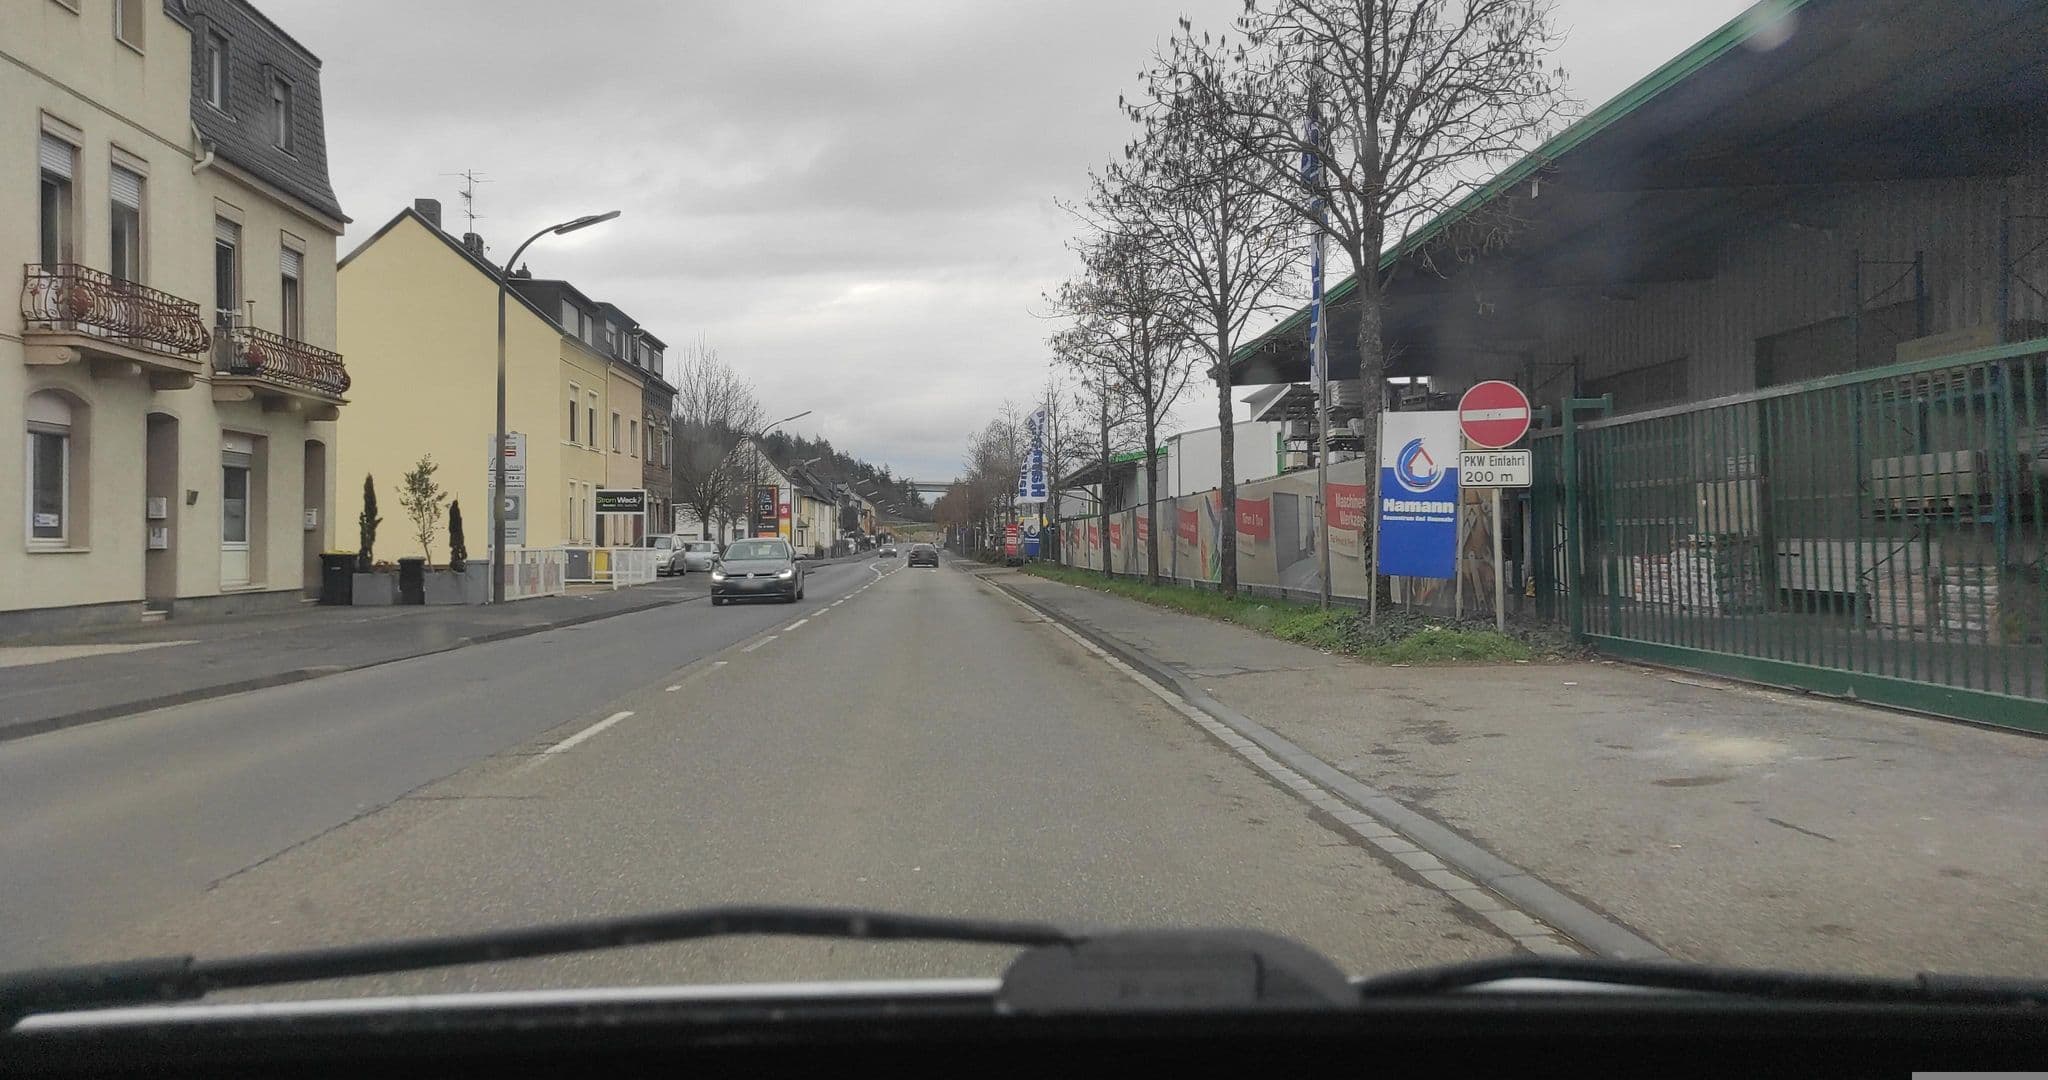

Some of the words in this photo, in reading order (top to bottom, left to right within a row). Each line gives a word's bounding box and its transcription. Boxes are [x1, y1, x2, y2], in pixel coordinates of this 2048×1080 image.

[1464, 455, 1486, 467] PKW
[1489, 455, 1525, 467] Einfahrt
[1465, 471, 1494, 482] 200
[1500, 473, 1514, 482] m
[1383, 497, 1455, 514] Hamann
